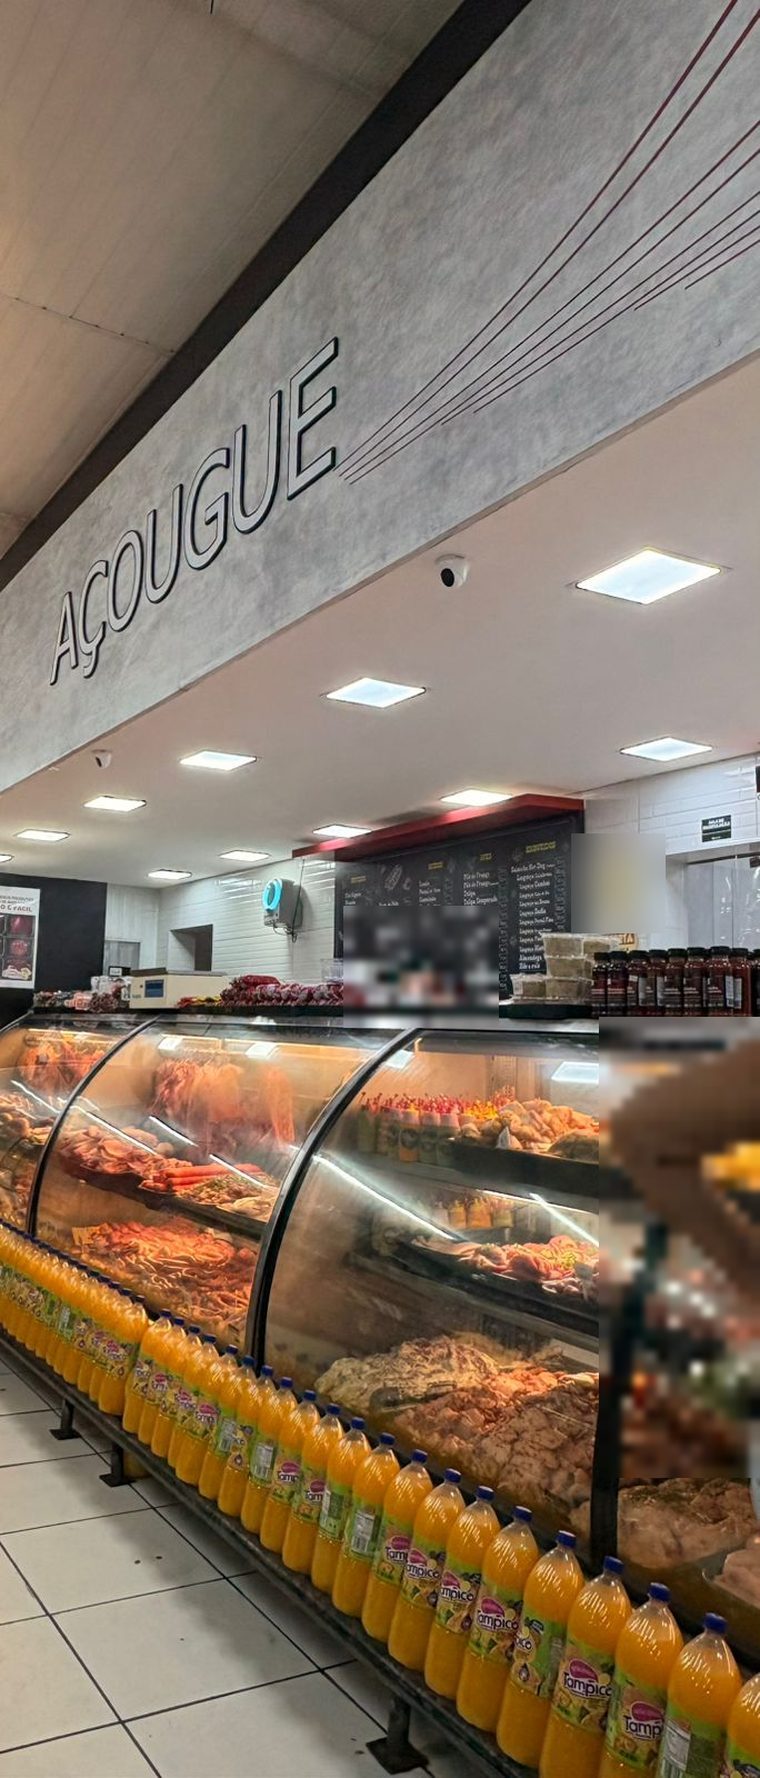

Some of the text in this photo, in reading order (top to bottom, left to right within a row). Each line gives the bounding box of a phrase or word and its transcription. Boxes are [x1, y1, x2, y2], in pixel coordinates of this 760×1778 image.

[50, 336, 339, 686] AÇOUGUE
[441, 1586, 475, 1603] mpico
[623, 1715, 663, 1740] Tamp
